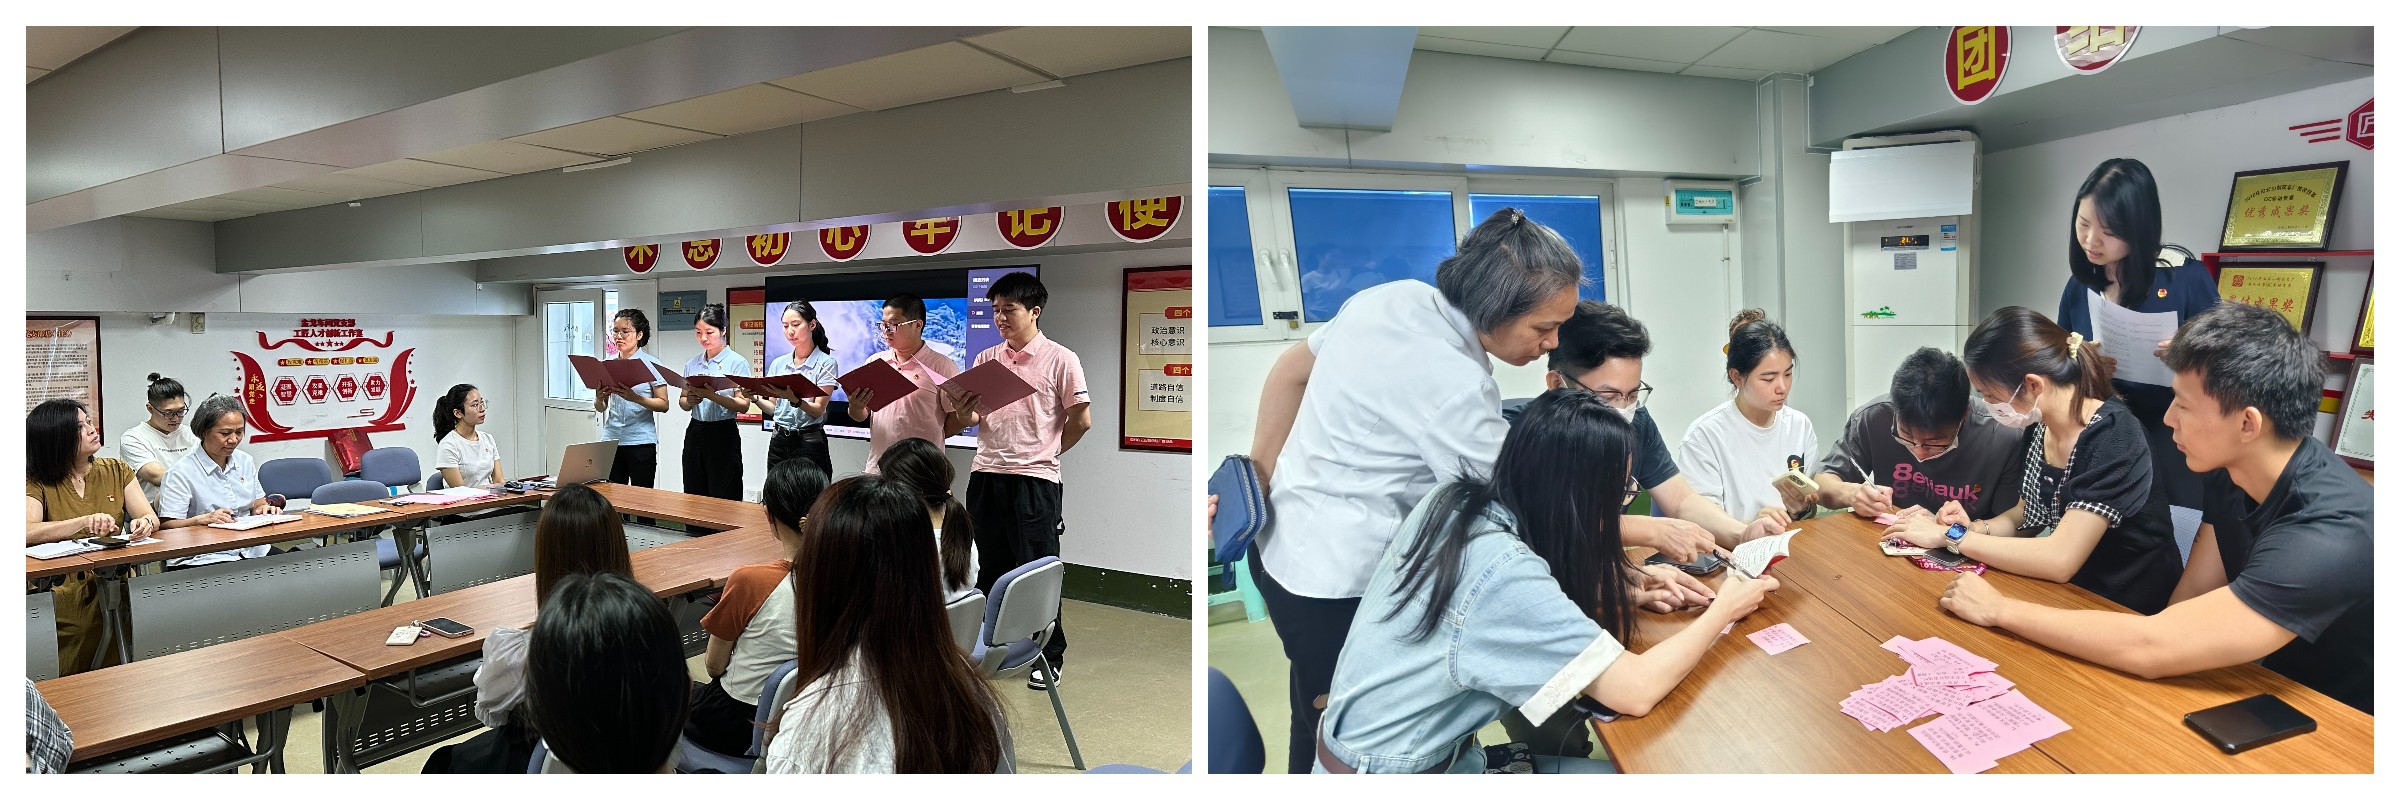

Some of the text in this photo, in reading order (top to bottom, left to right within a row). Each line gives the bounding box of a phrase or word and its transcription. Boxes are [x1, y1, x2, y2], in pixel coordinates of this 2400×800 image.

[2244, 204, 2310, 218] 优秀成果奖
[1174, 309, 1191, 317] 四个
[1151, 326, 1185, 335] 政治意识
[1150, 338, 1185, 347] 核心意识
[1173, 366, 1192, 375] 四个
[1150, 383, 1184, 392] 道路自信
[1149, 394, 1184, 404] 制度自信
